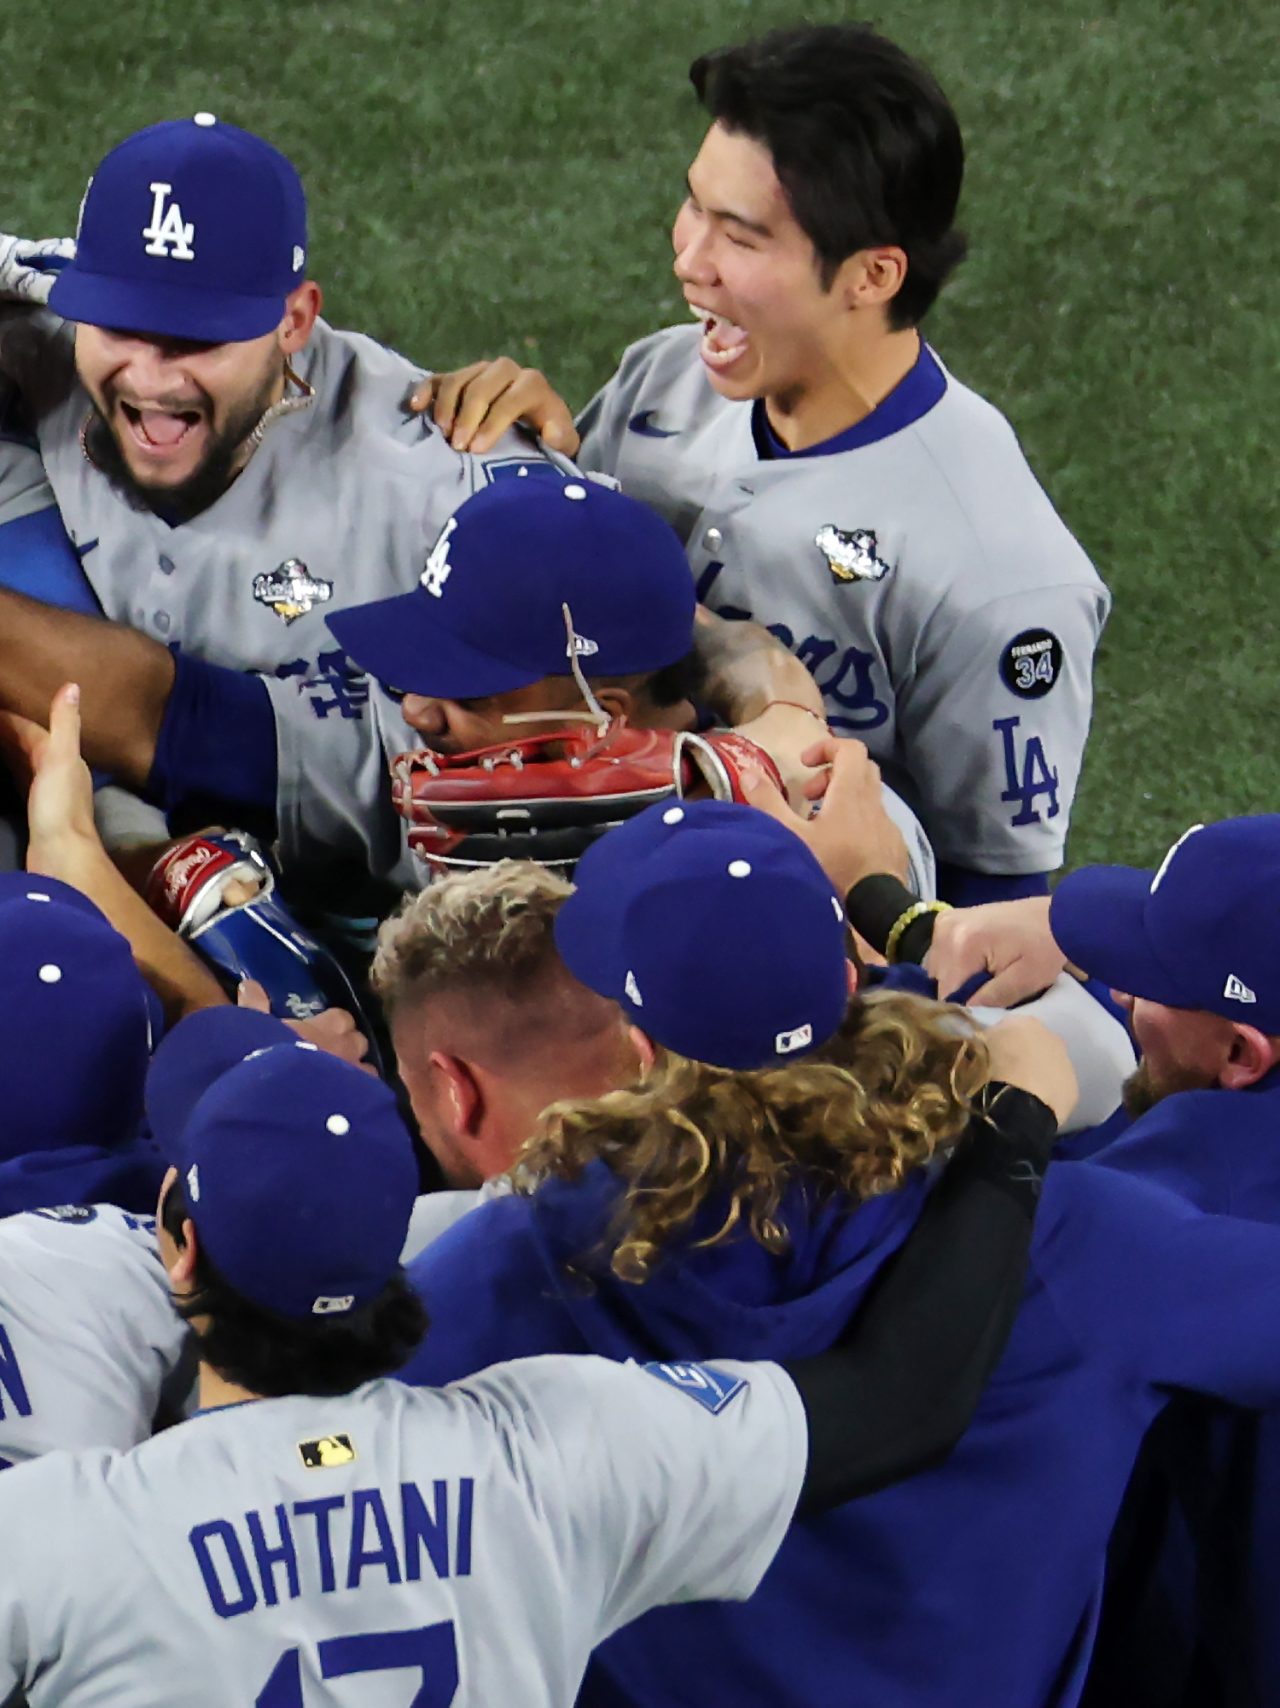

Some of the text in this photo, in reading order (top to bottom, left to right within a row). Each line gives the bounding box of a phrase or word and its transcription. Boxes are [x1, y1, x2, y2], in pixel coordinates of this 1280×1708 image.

[142, 182, 195, 260] LA
[420, 517, 458, 598] LA
[1014, 655, 1053, 689] 34
[993, 716, 1059, 828] LA
[189, 1477, 475, 1619] OHTANI
